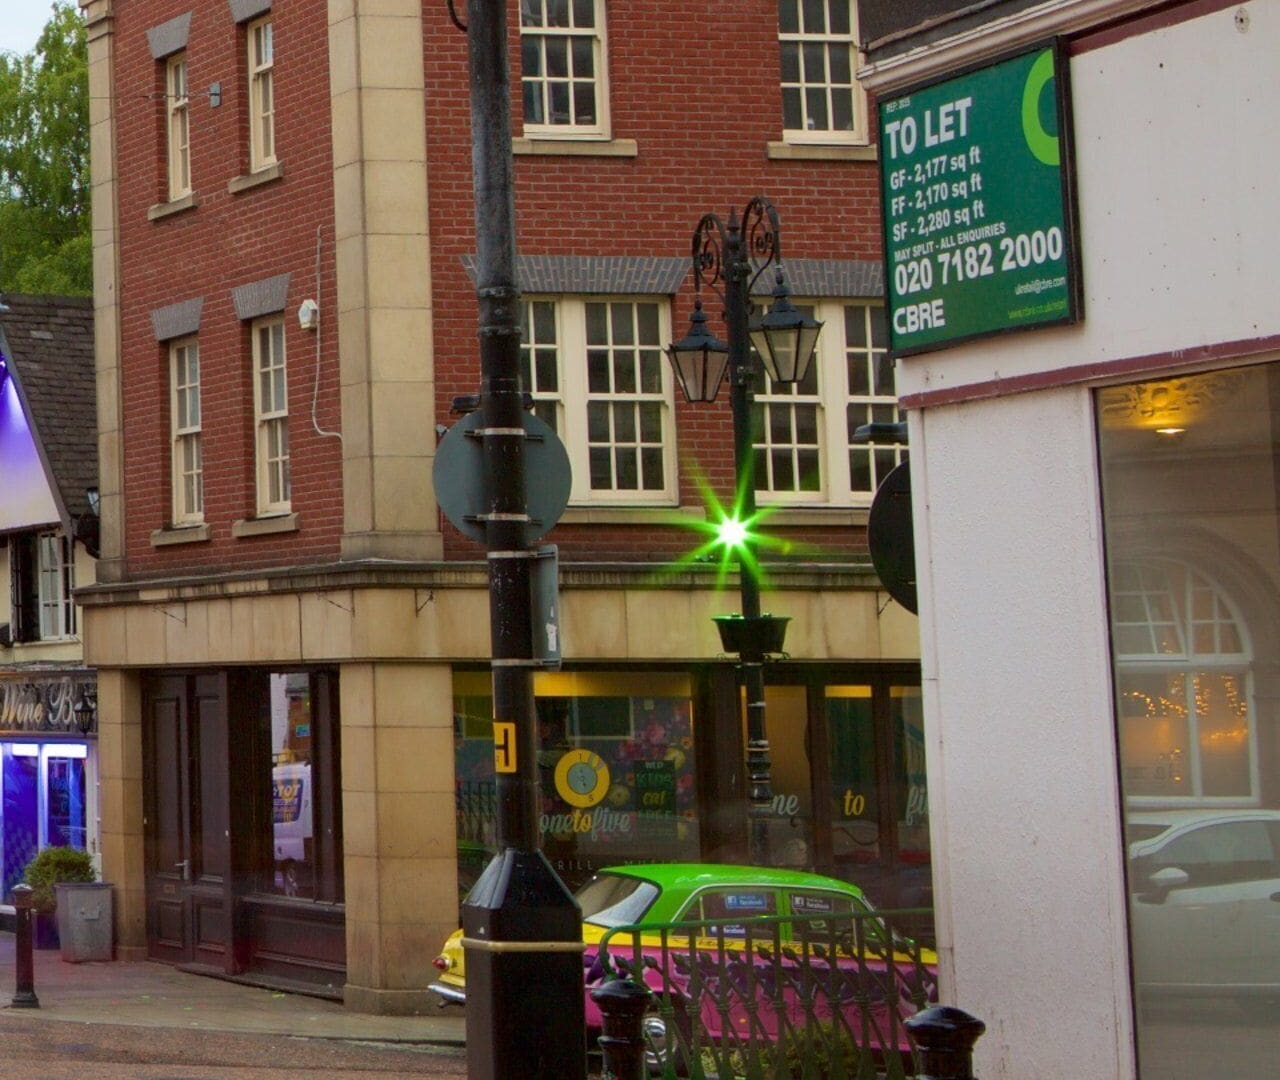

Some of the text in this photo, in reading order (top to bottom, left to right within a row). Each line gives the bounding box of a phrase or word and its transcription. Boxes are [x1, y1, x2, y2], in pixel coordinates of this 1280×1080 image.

[885, 96, 972, 159] TO LET
[891, 170, 906, 190] GF
[914, 155, 947, 184] 2,177
[950, 154, 966, 171] sq
[969, 145, 981, 165] ft
[891, 196, 905, 216] FF
[915, 182, 948, 211] 2,170
[951, 181, 967, 199] sq
[970, 173, 982, 192] ft
[893, 222, 907, 242] SF
[917, 209, 950, 236] 2,280
[954, 207, 970, 226] sq
[972, 200, 984, 218] ft
[894, 248, 911, 262] MAY
[912, 241, 934, 258] SPLIT
[940, 237, 956, 250] ALL
[957, 222, 1006, 244] ENQUIRIES
[895, 226, 1063, 296] 020 7182 2000
[893, 298, 946, 335] CBRE
[0, 684, 43, 726] Wine
[771, 794, 801, 816] ne
[844, 789, 865, 816] to
[558, 860, 593, 870] RILL
